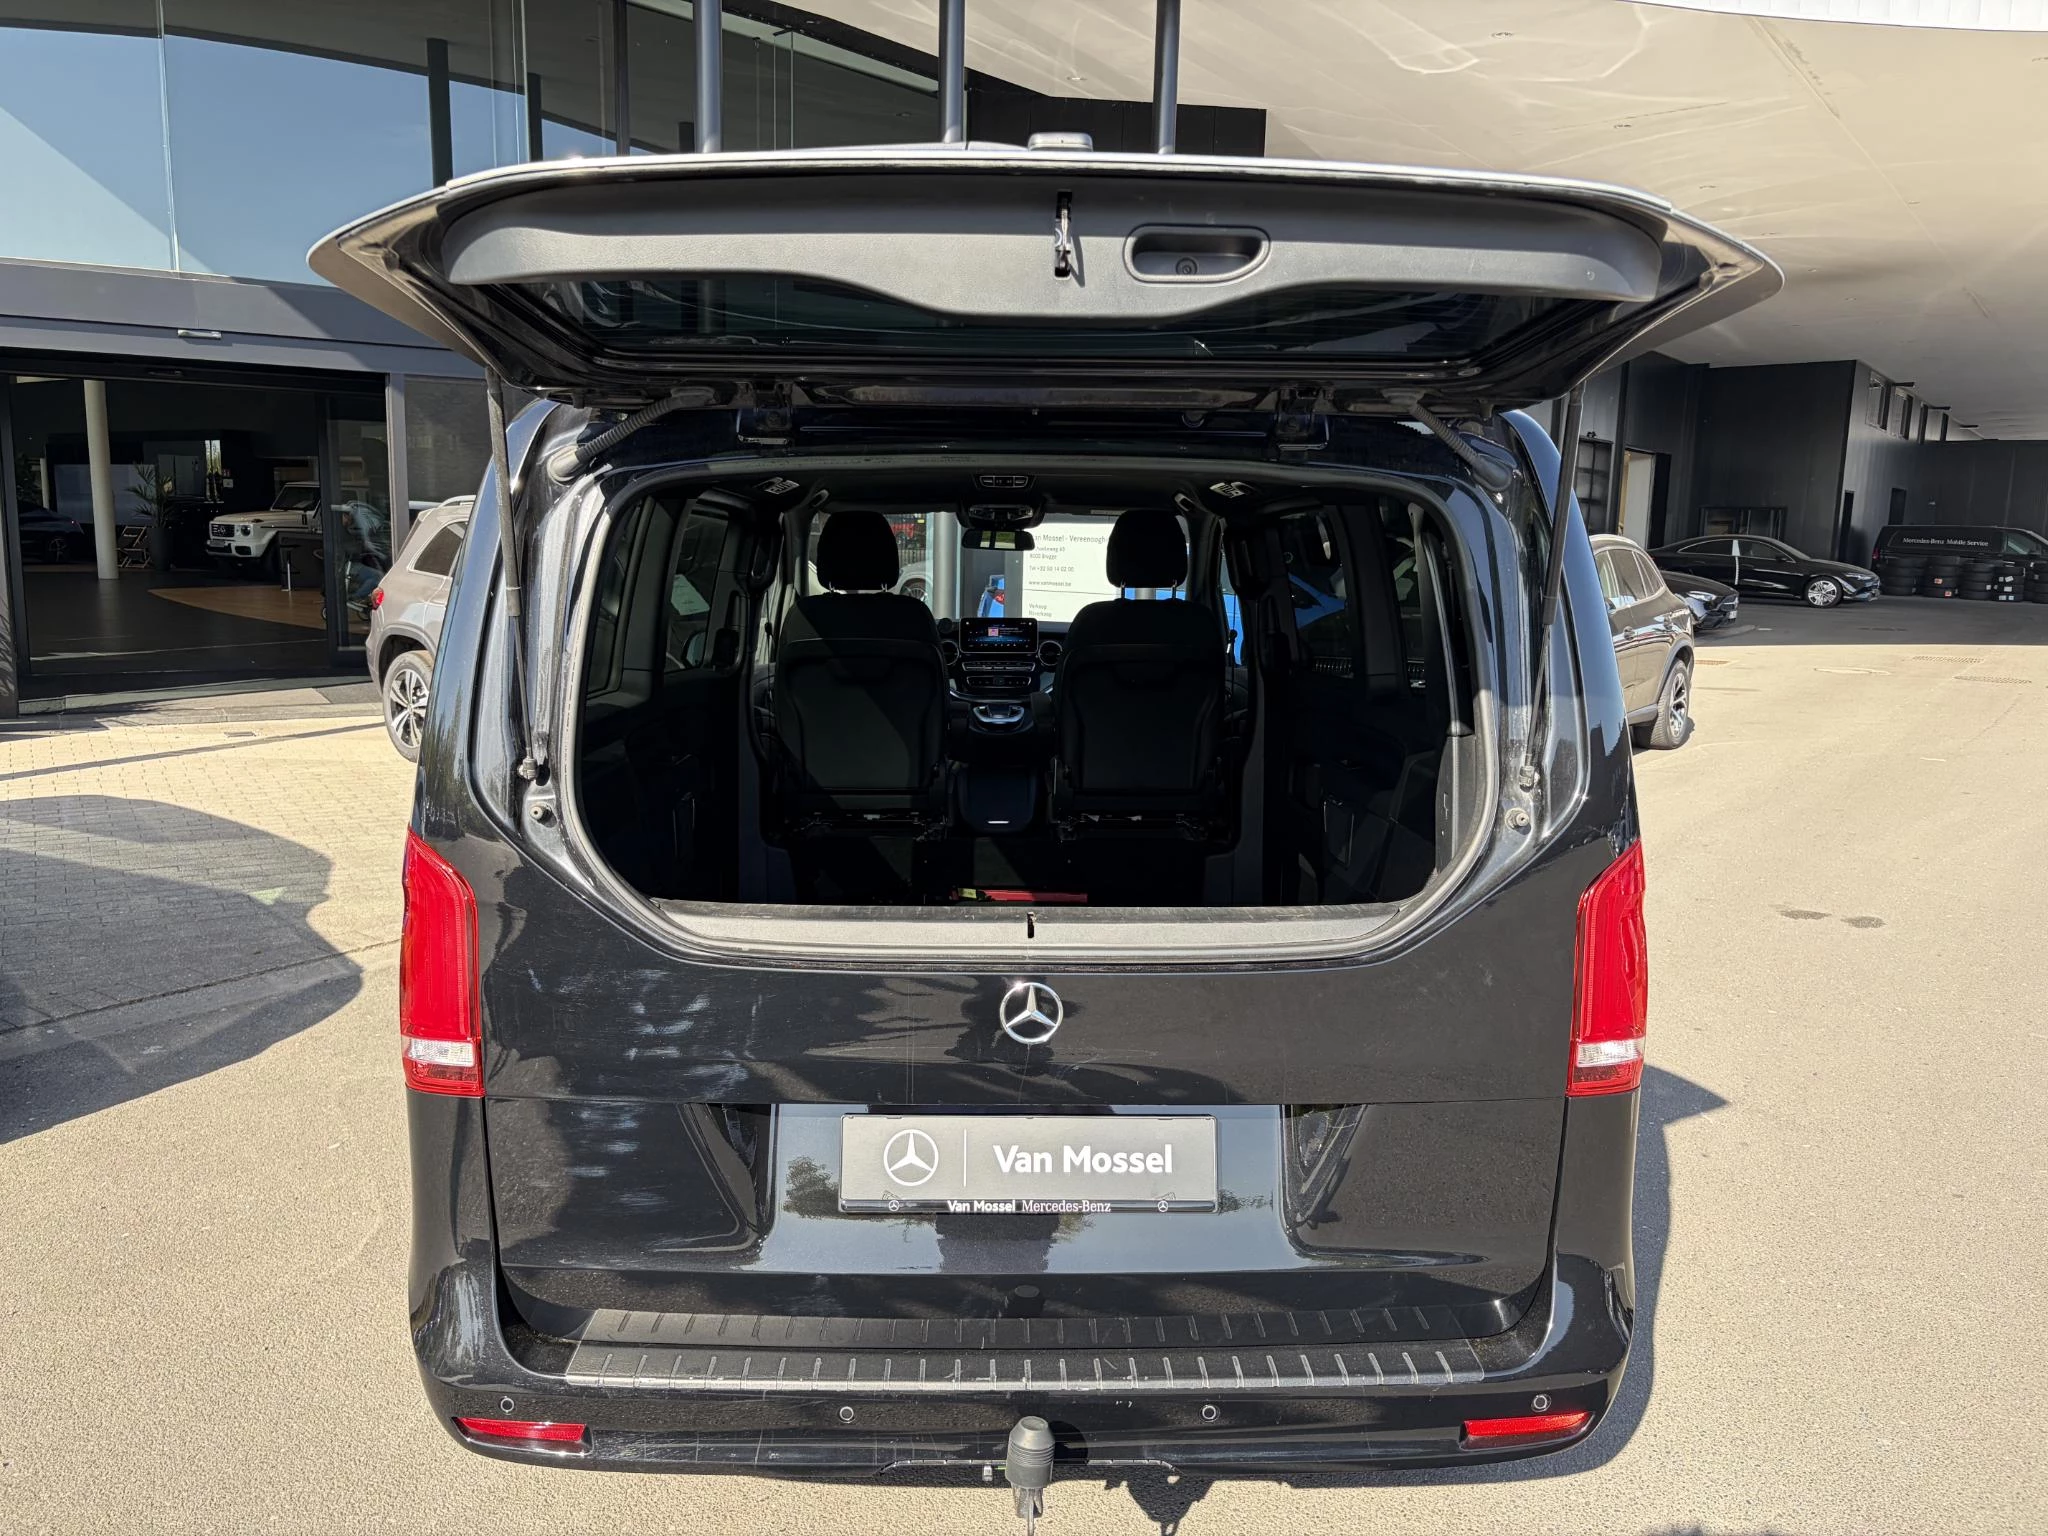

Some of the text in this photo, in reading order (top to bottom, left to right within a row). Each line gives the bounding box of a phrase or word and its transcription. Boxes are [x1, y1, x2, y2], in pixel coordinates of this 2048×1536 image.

[1069, 535, 1108, 544] Vereenoogh
[992, 1145, 1172, 1174] Van Mossel
[947, 1200, 1112, 1212] Van Mossel Mercedes-Benz
